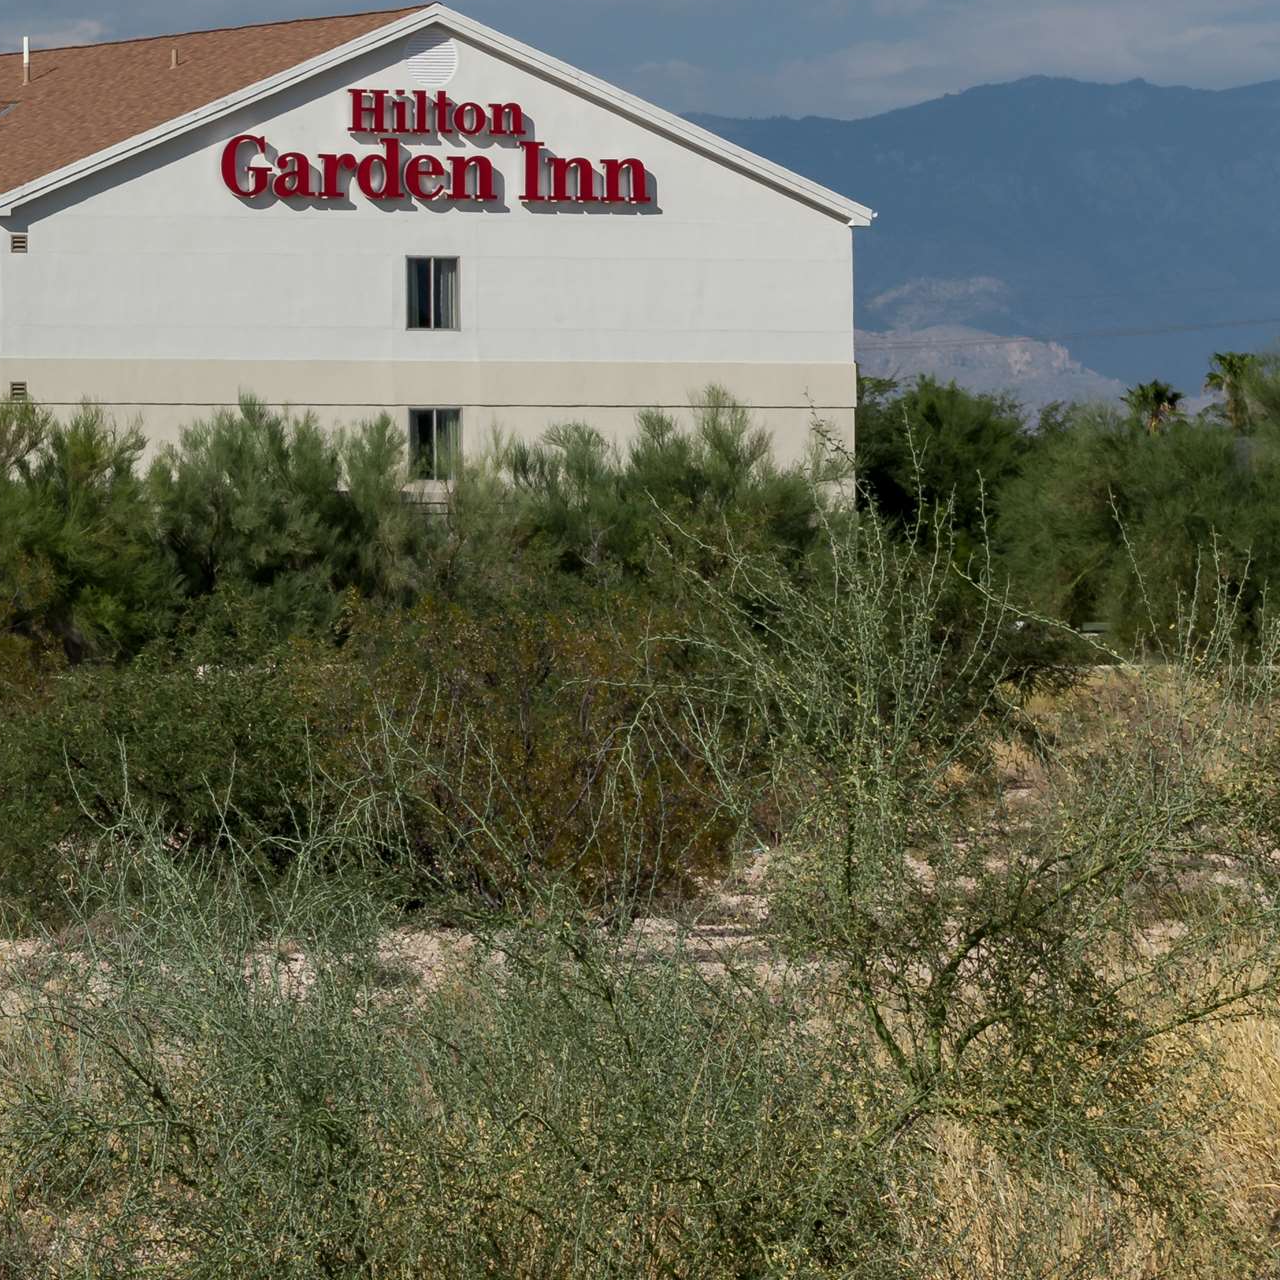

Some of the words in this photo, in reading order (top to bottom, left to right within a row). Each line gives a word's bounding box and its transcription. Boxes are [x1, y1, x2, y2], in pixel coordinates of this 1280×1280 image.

[347, 88, 526, 137] Hilton
[220, 134, 498, 201] Garden
[518, 140, 652, 204] Inn
